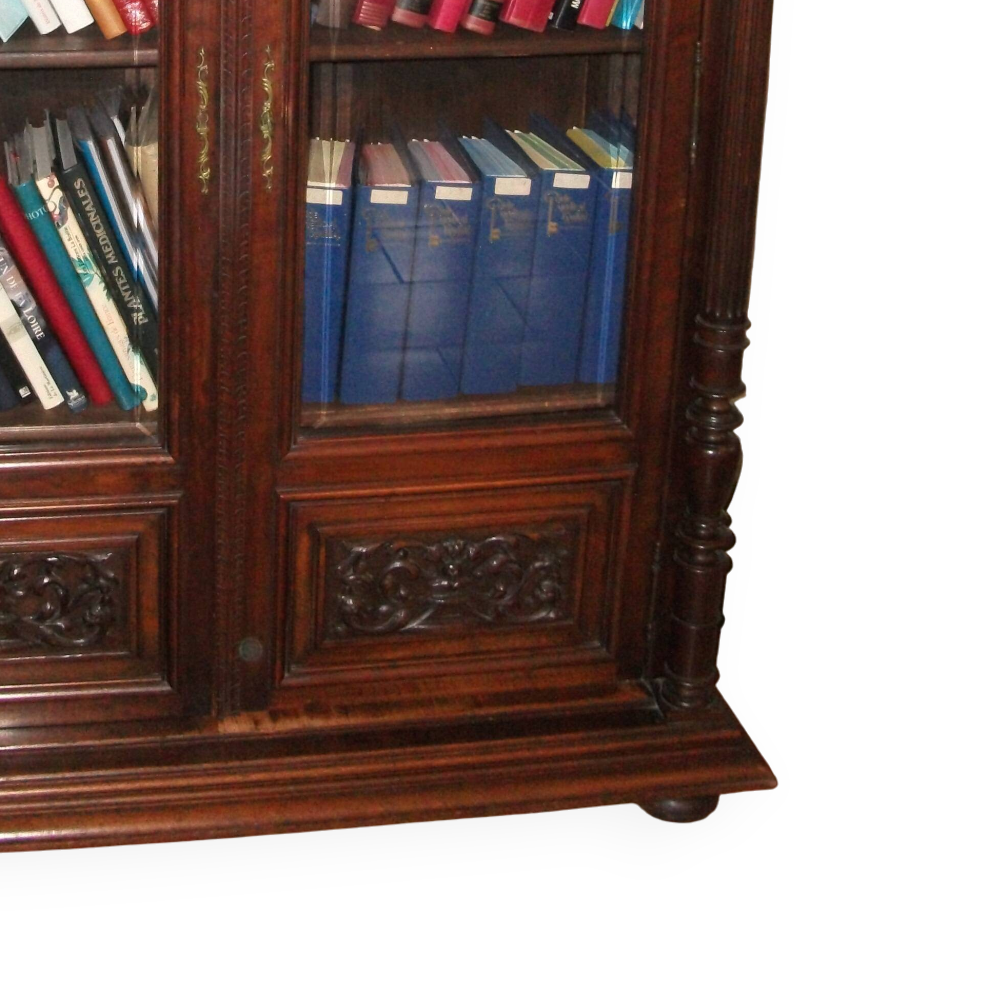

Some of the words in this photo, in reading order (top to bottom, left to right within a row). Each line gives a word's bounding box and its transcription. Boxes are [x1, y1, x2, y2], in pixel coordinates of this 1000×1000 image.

[5, 275, 20, 291] DE
[21, 306, 46, 340] LOIRE
[109, 263, 149, 327] PLANTES
